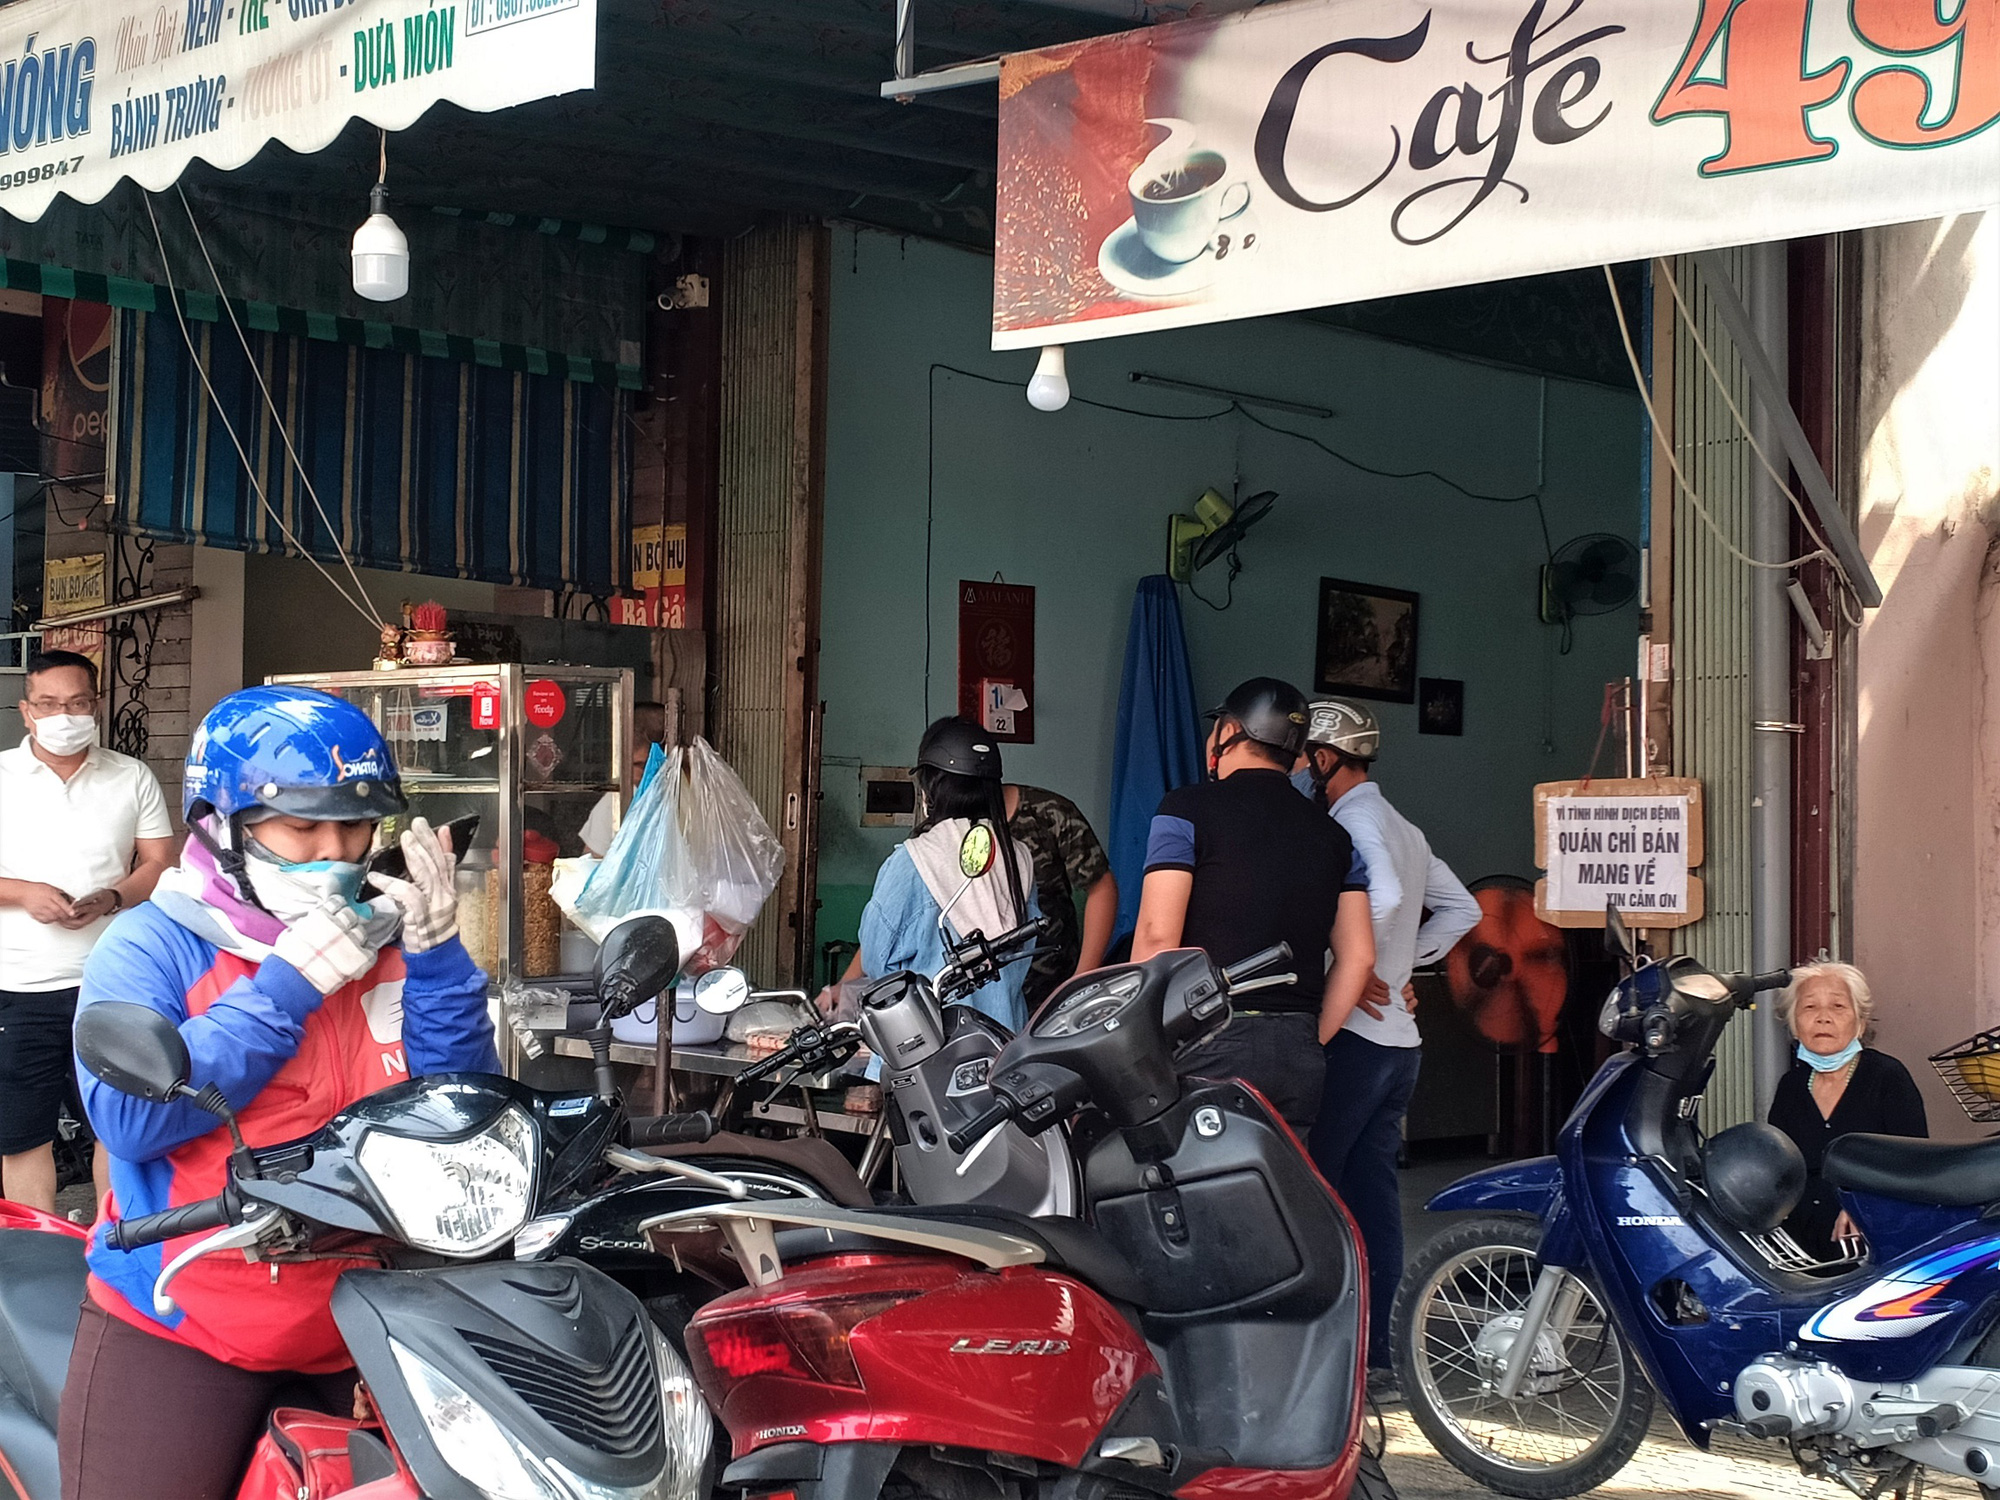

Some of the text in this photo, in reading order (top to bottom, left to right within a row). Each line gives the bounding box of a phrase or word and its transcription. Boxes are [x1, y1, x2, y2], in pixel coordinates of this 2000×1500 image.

[109, 86, 160, 159] BÁNH
[353, 17, 396, 93] DƯA
[403, 0, 456, 81] MÓN
[1648, 0, 2000, 179] 49
[1568, 805, 1591, 821] TÌNH
[1594, 805, 1619, 821] HÌNH
[1622, 807, 1648, 823] DỊCH
[1650, 804, 1680, 823] BỆNH
[1558, 825, 1680, 855] QUÁN CHỈ BÁN
[1578, 857, 1656, 885] MANG VỀ
[1629, 889, 1656, 908] CẢM
[1659, 892, 1677, 908] ƠN
[1616, 1215, 1685, 1227] HONDA
[580, 1236, 647, 1251] Scoo
[950, 1338, 1071, 1356] LEAD
[759, 1424, 808, 1439] HONDA
